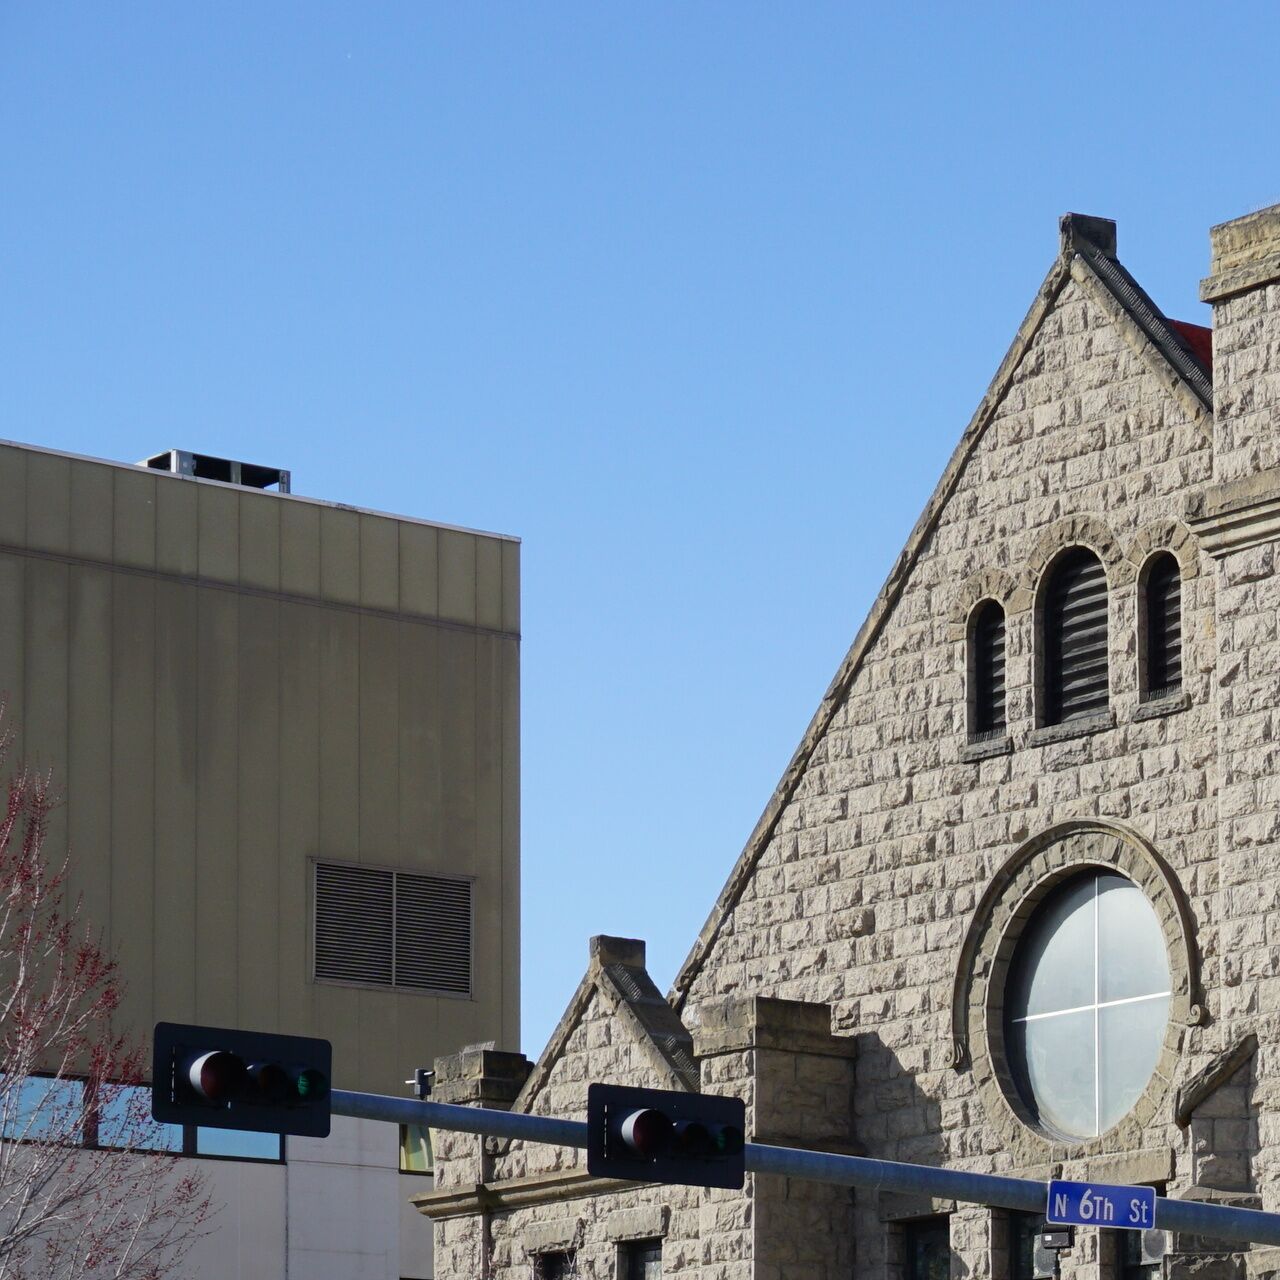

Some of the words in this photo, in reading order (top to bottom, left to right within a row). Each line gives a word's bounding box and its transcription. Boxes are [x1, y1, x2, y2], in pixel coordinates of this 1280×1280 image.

[1054, 1193, 1067, 1218] N
[1080, 1188, 1114, 1221] 6Th
[1129, 1199, 1148, 1223] St
